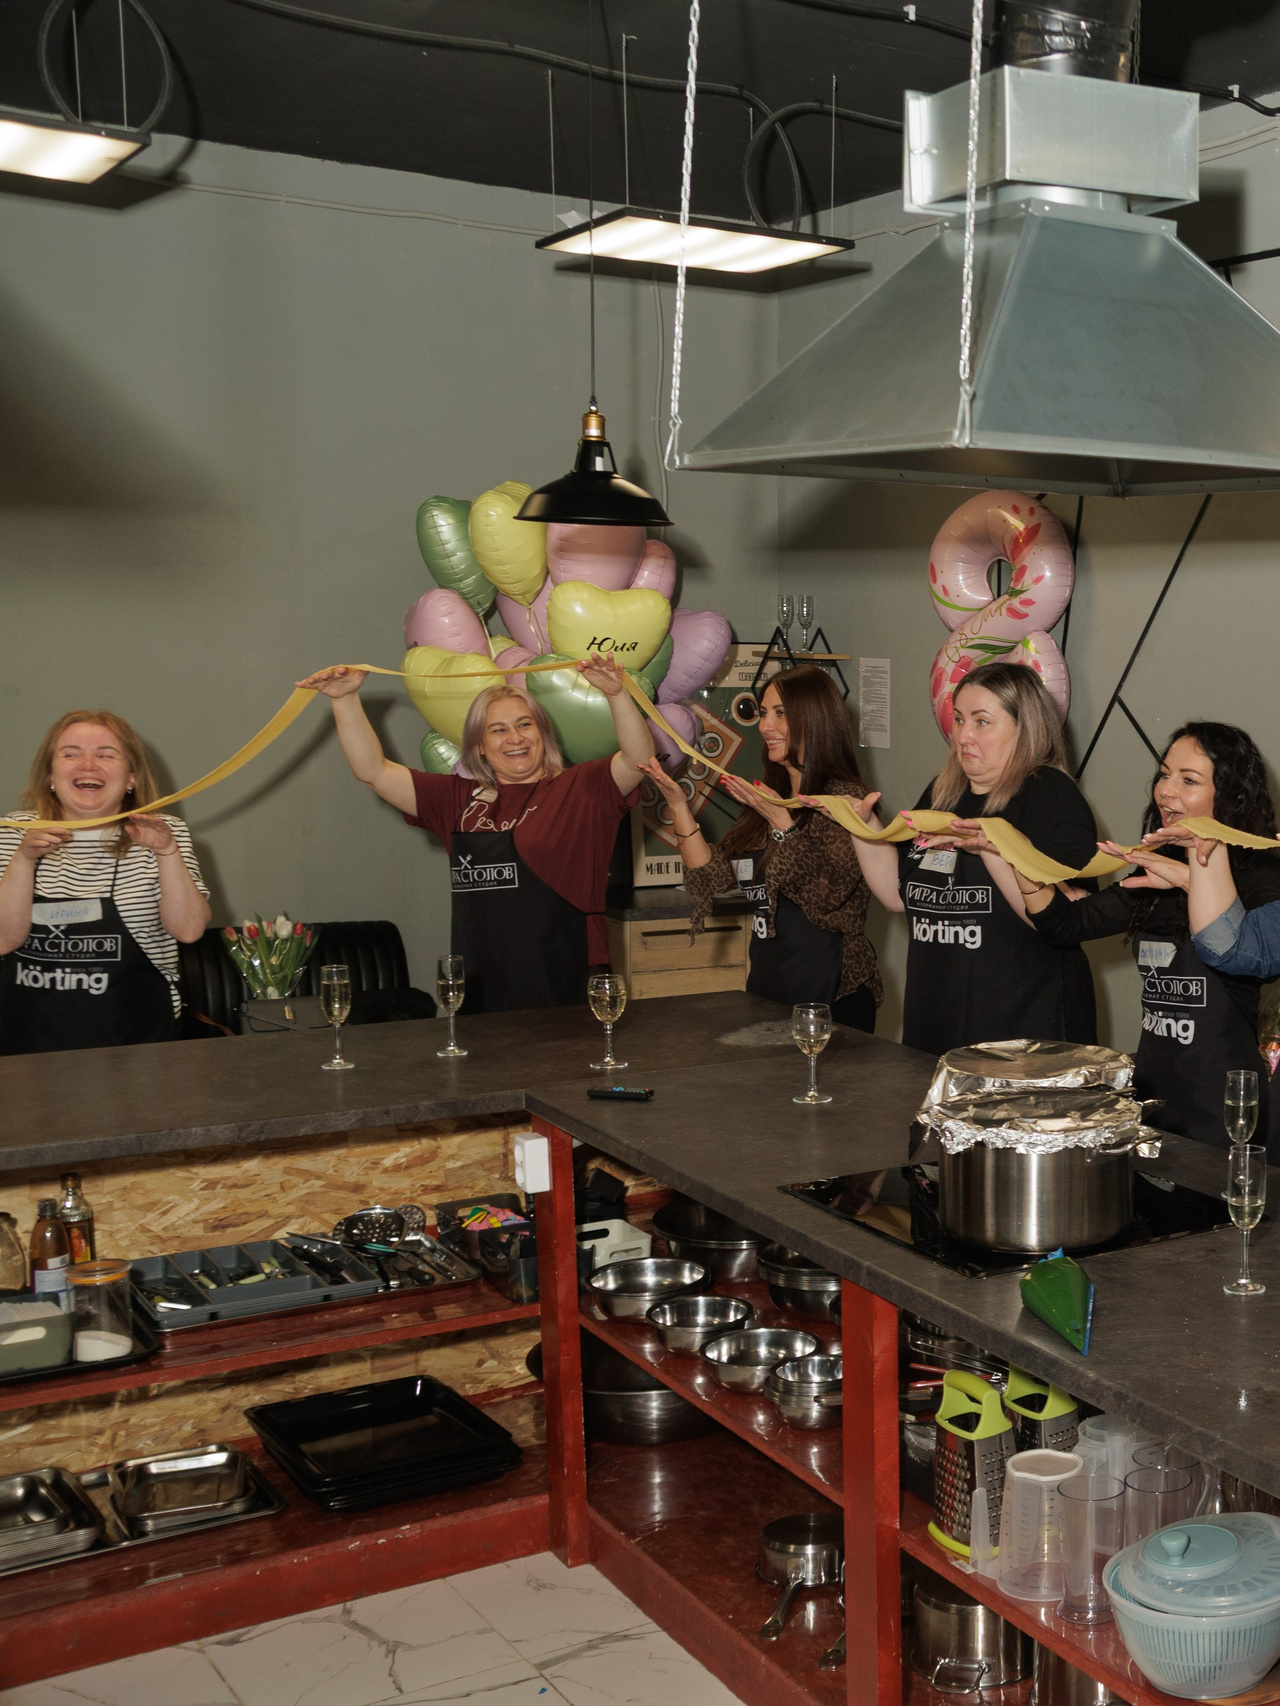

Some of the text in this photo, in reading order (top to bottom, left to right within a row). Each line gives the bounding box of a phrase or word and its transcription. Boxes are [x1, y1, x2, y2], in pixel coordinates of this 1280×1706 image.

[586, 636, 639, 653] Юля
[461, 866, 514, 883] СТОЛОВ
[645, 861, 671, 875] MADE
[908, 885, 988, 904] ИГРА СТОЛОВ
[912, 916, 982, 949] körting
[45, 938, 117, 953] СТОЛОВ
[16, 962, 109, 995] körting
[1144, 977, 1202, 996] СТОЛОВ
